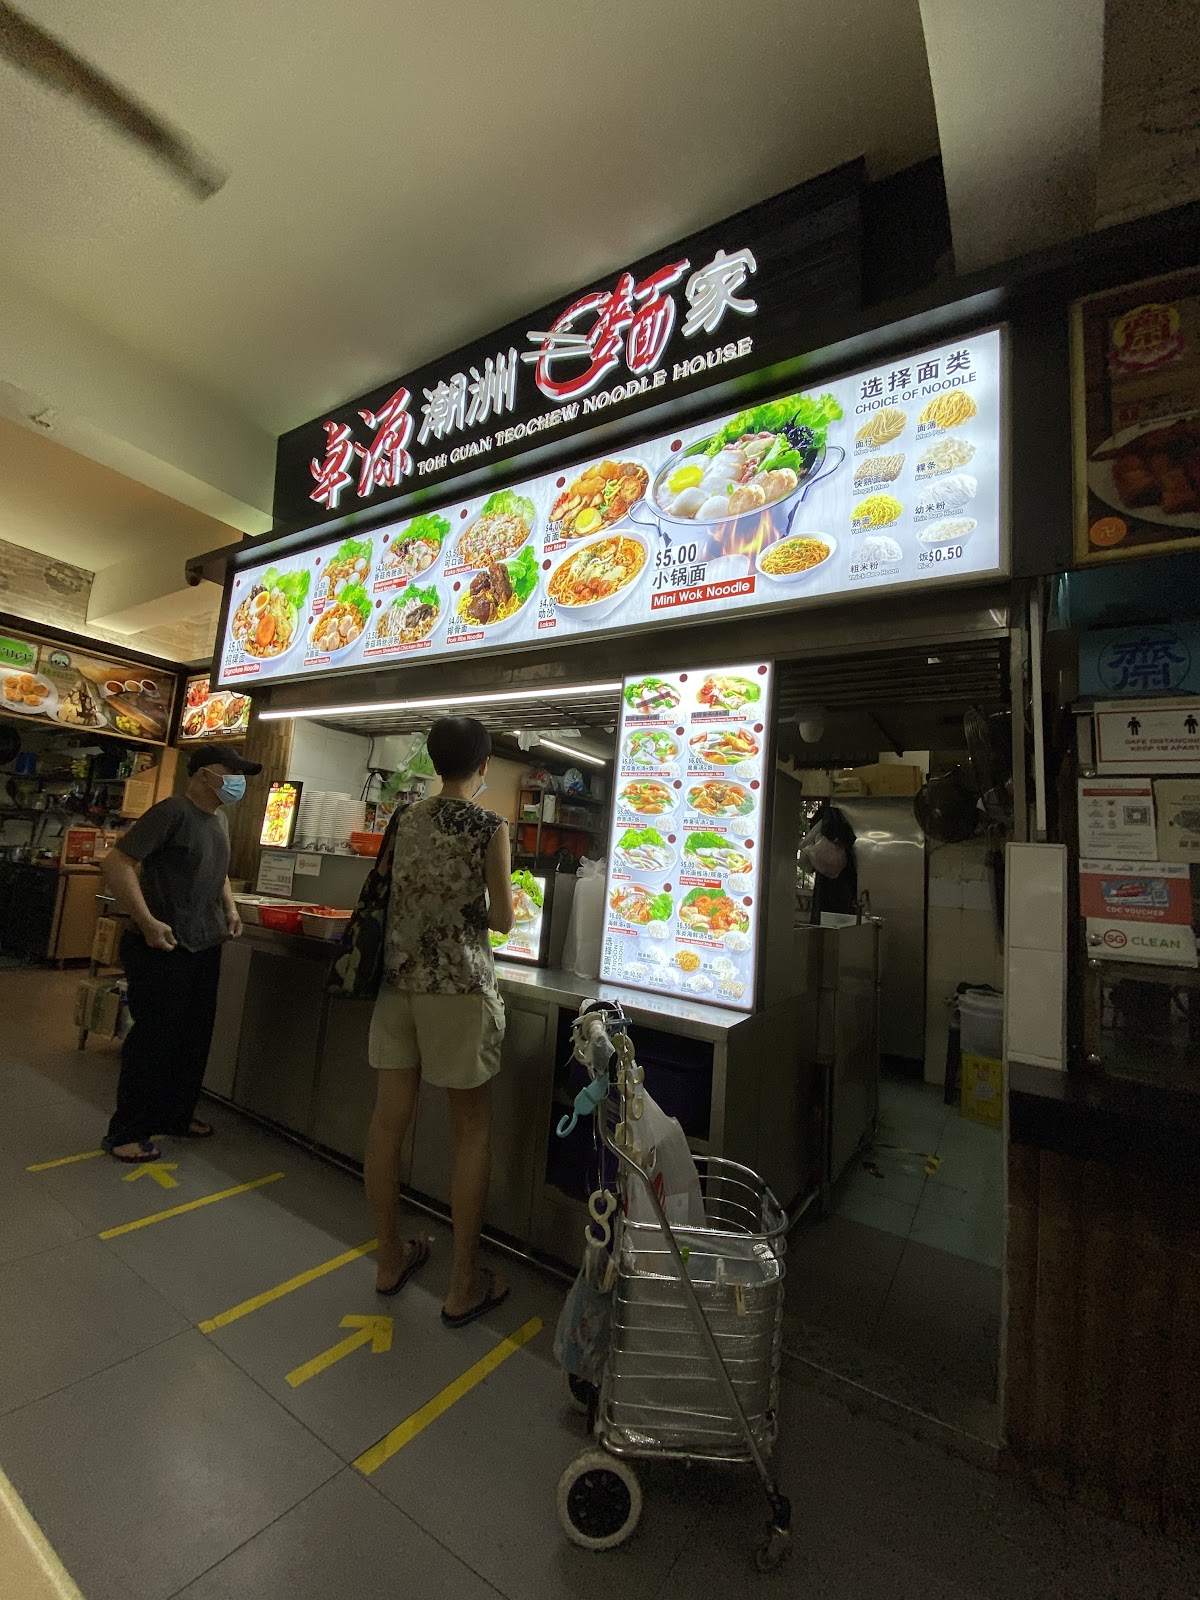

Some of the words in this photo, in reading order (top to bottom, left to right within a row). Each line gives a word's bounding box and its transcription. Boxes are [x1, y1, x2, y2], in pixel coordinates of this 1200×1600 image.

[860, 350, 971, 400] 选择面类
[855, 394, 899, 415] CHOICE
[902, 389, 920, 401] OF
[921, 371, 977, 396] NOODLE
[417, 454, 448, 476] TOH
[450, 438, 492, 464] GUAN
[495, 402, 579, 447] TEOCHEW
[582, 369, 668, 415] NOODLE
[672, 337, 753, 379] HOUSE
[914, 501, 946, 515] 幼米粉
[546, 520, 564, 533] $4.00
[656, 543, 697, 567] $5.00
[929, 545, 963, 562] $0.50
[850, 560, 879, 573] 粗米粉
[652, 563, 707, 590] 小锅面
[654, 591, 676, 607] Mini
[679, 587, 702, 603] Wok
[706, 581, 751, 598] Noodle
[540, 597, 557, 607] $4.00
[539, 608, 555, 619] 叻沙
[540, 621, 555, 629] Laksa
[229, 640, 244, 652] $5.00
[244, 663, 260, 672] Noodle
[1131, 936, 1181, 949] CLEAN
